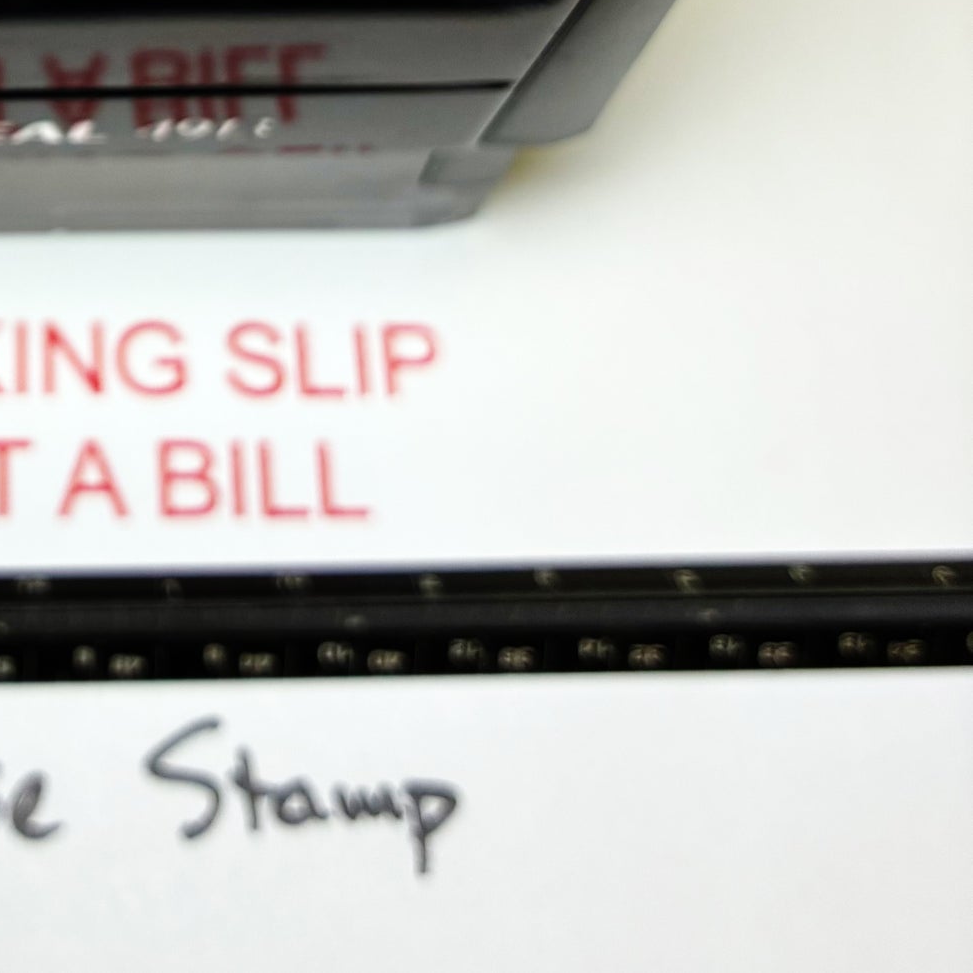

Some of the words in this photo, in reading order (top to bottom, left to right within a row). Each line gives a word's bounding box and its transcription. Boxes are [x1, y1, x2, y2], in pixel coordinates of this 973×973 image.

[225, 319, 441, 400] SLIP
[57, 438, 130, 519] A
[156, 437, 371, 521] BILL
[144, 716, 459, 875] Stamp
